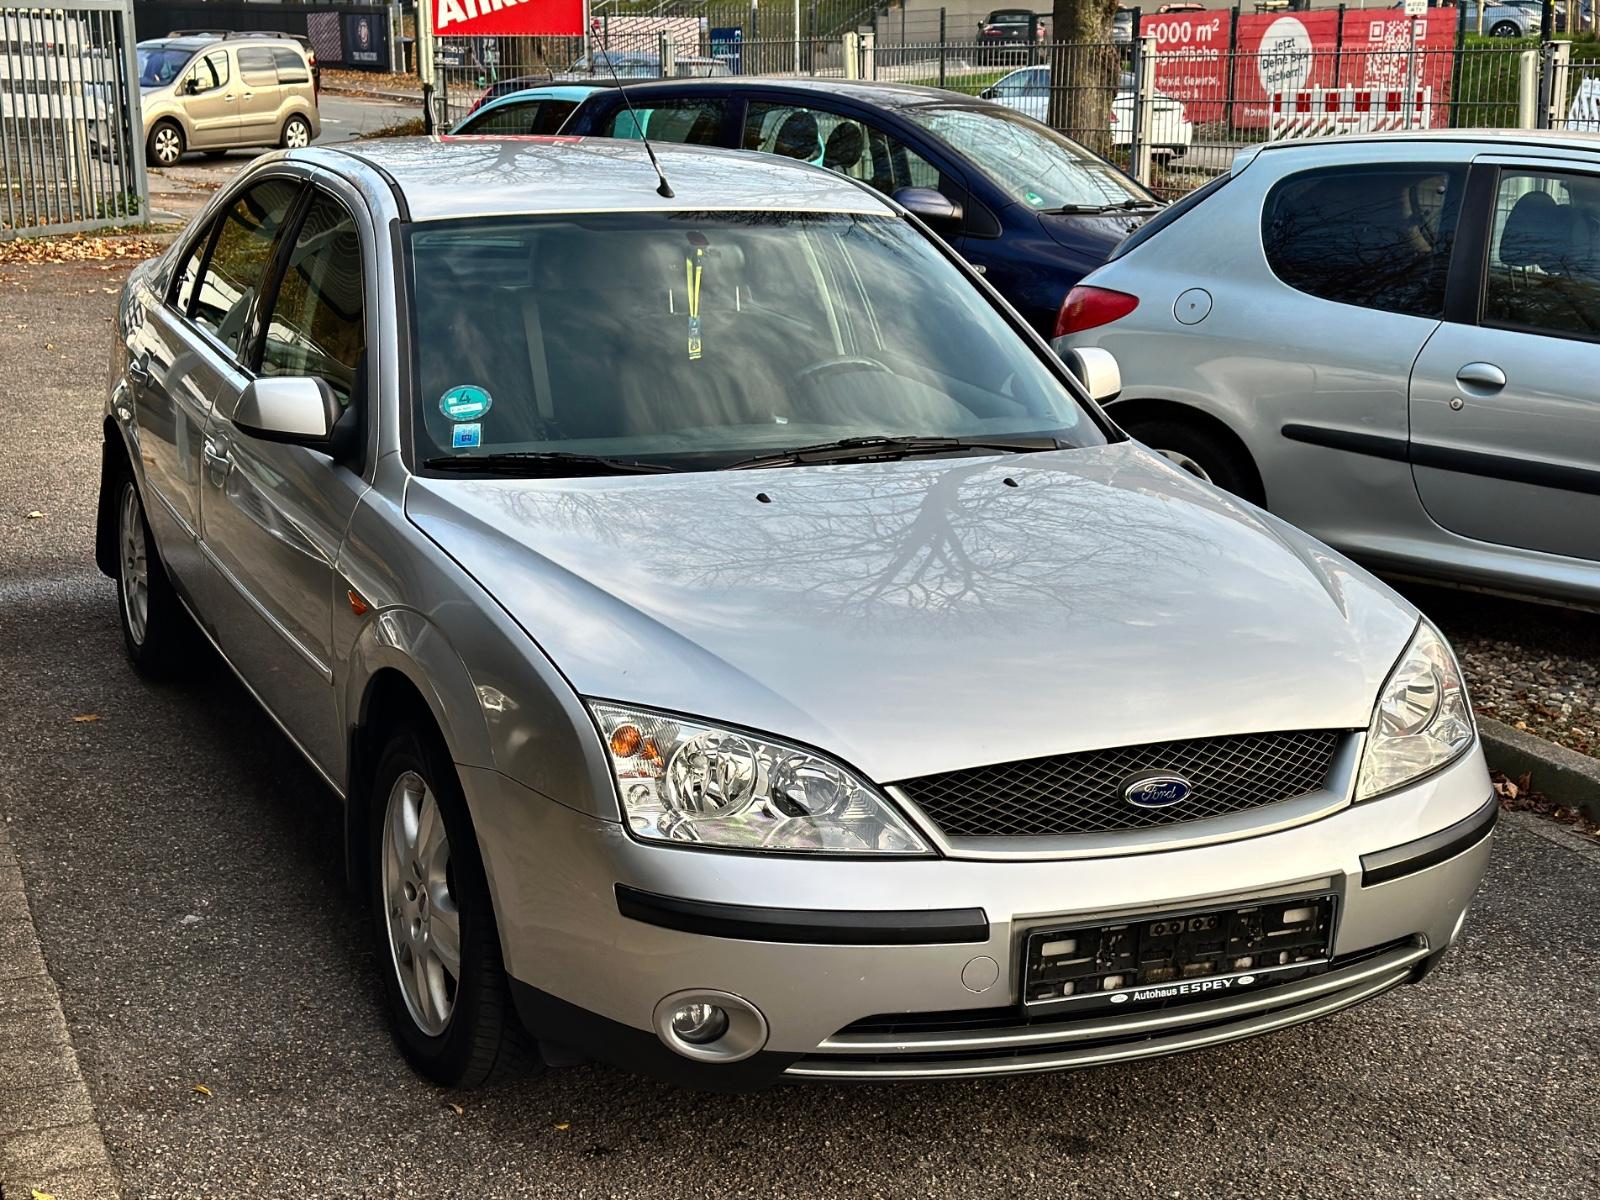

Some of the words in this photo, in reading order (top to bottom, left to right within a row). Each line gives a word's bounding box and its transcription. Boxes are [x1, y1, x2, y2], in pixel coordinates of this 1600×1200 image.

[1147, 21, 1192, 44] 5000
[1273, 37, 1296, 52] Jetzt
[1155, 45, 1219, 66] agerfläche
[458, 390, 471, 403] 4
[1141, 783, 1177, 801] Ford
[1133, 986, 1178, 1002] Autohaus
[1180, 978, 1234, 995] ESPEY
